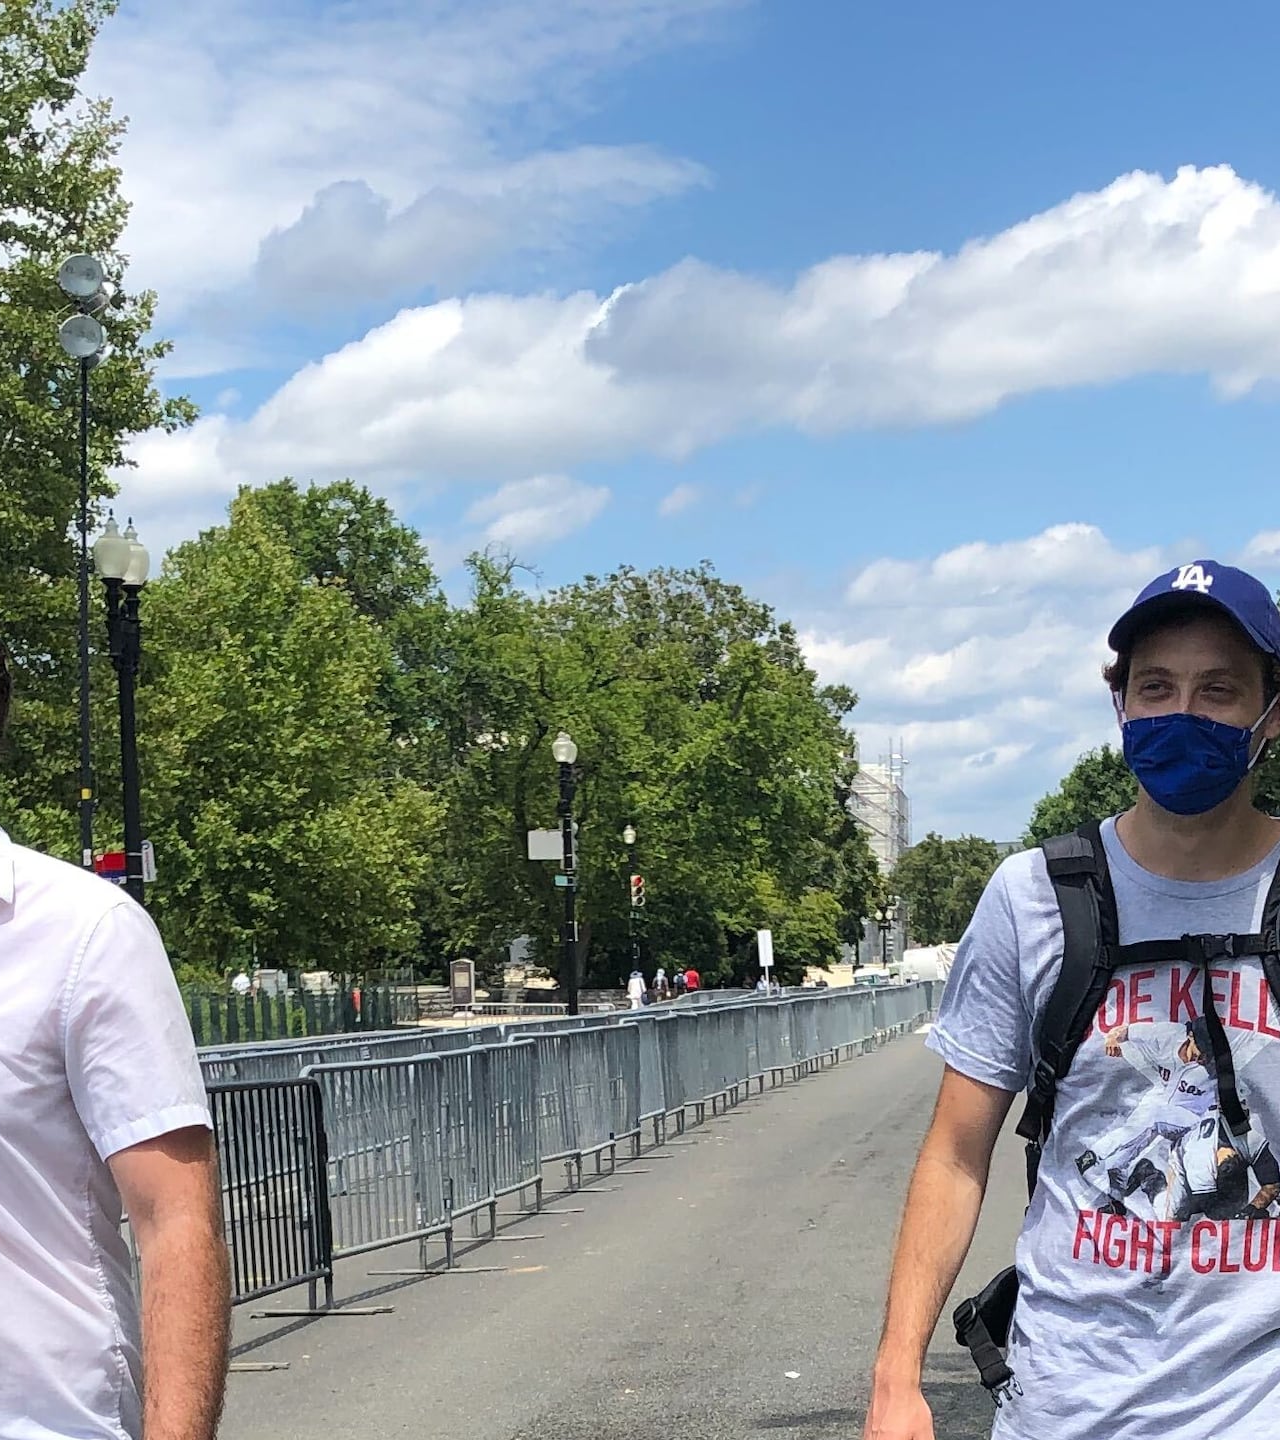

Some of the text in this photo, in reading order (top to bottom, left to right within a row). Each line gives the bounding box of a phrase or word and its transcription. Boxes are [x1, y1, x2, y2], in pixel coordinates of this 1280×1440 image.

[1172, 564, 1213, 593] LA
[1084, 968, 1156, 1042] OE
[1072, 1209, 1182, 1274] FIGHT
